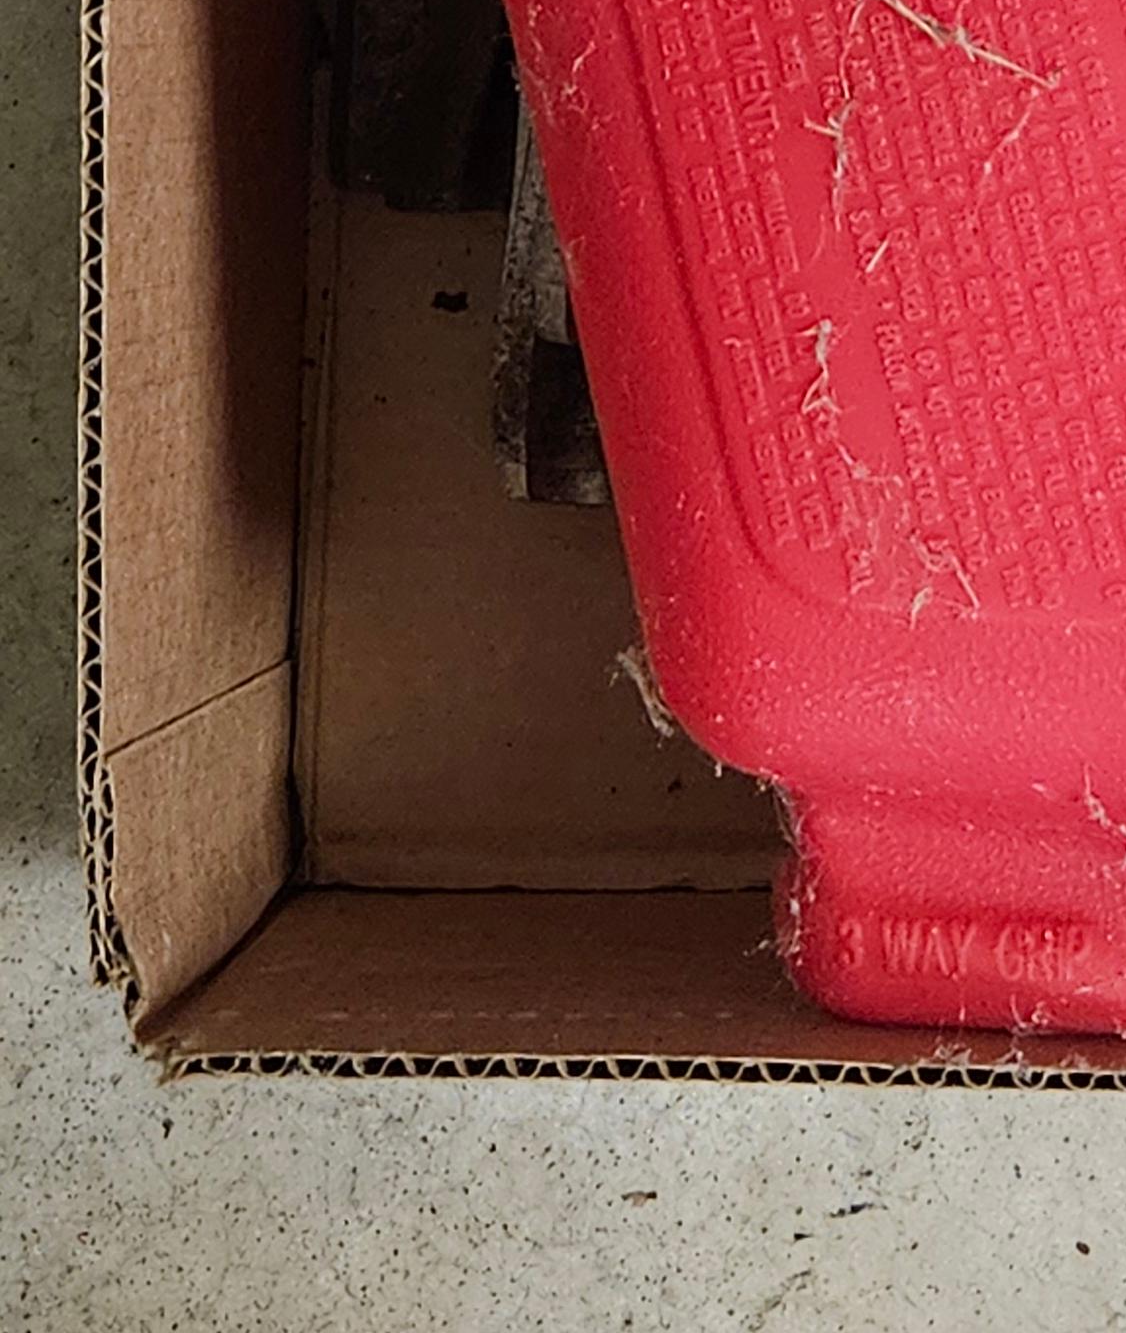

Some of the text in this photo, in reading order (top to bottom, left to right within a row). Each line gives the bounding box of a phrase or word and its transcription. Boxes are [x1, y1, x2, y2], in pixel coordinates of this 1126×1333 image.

[837, 917, 1090, 983] 3 WAY GRIP
